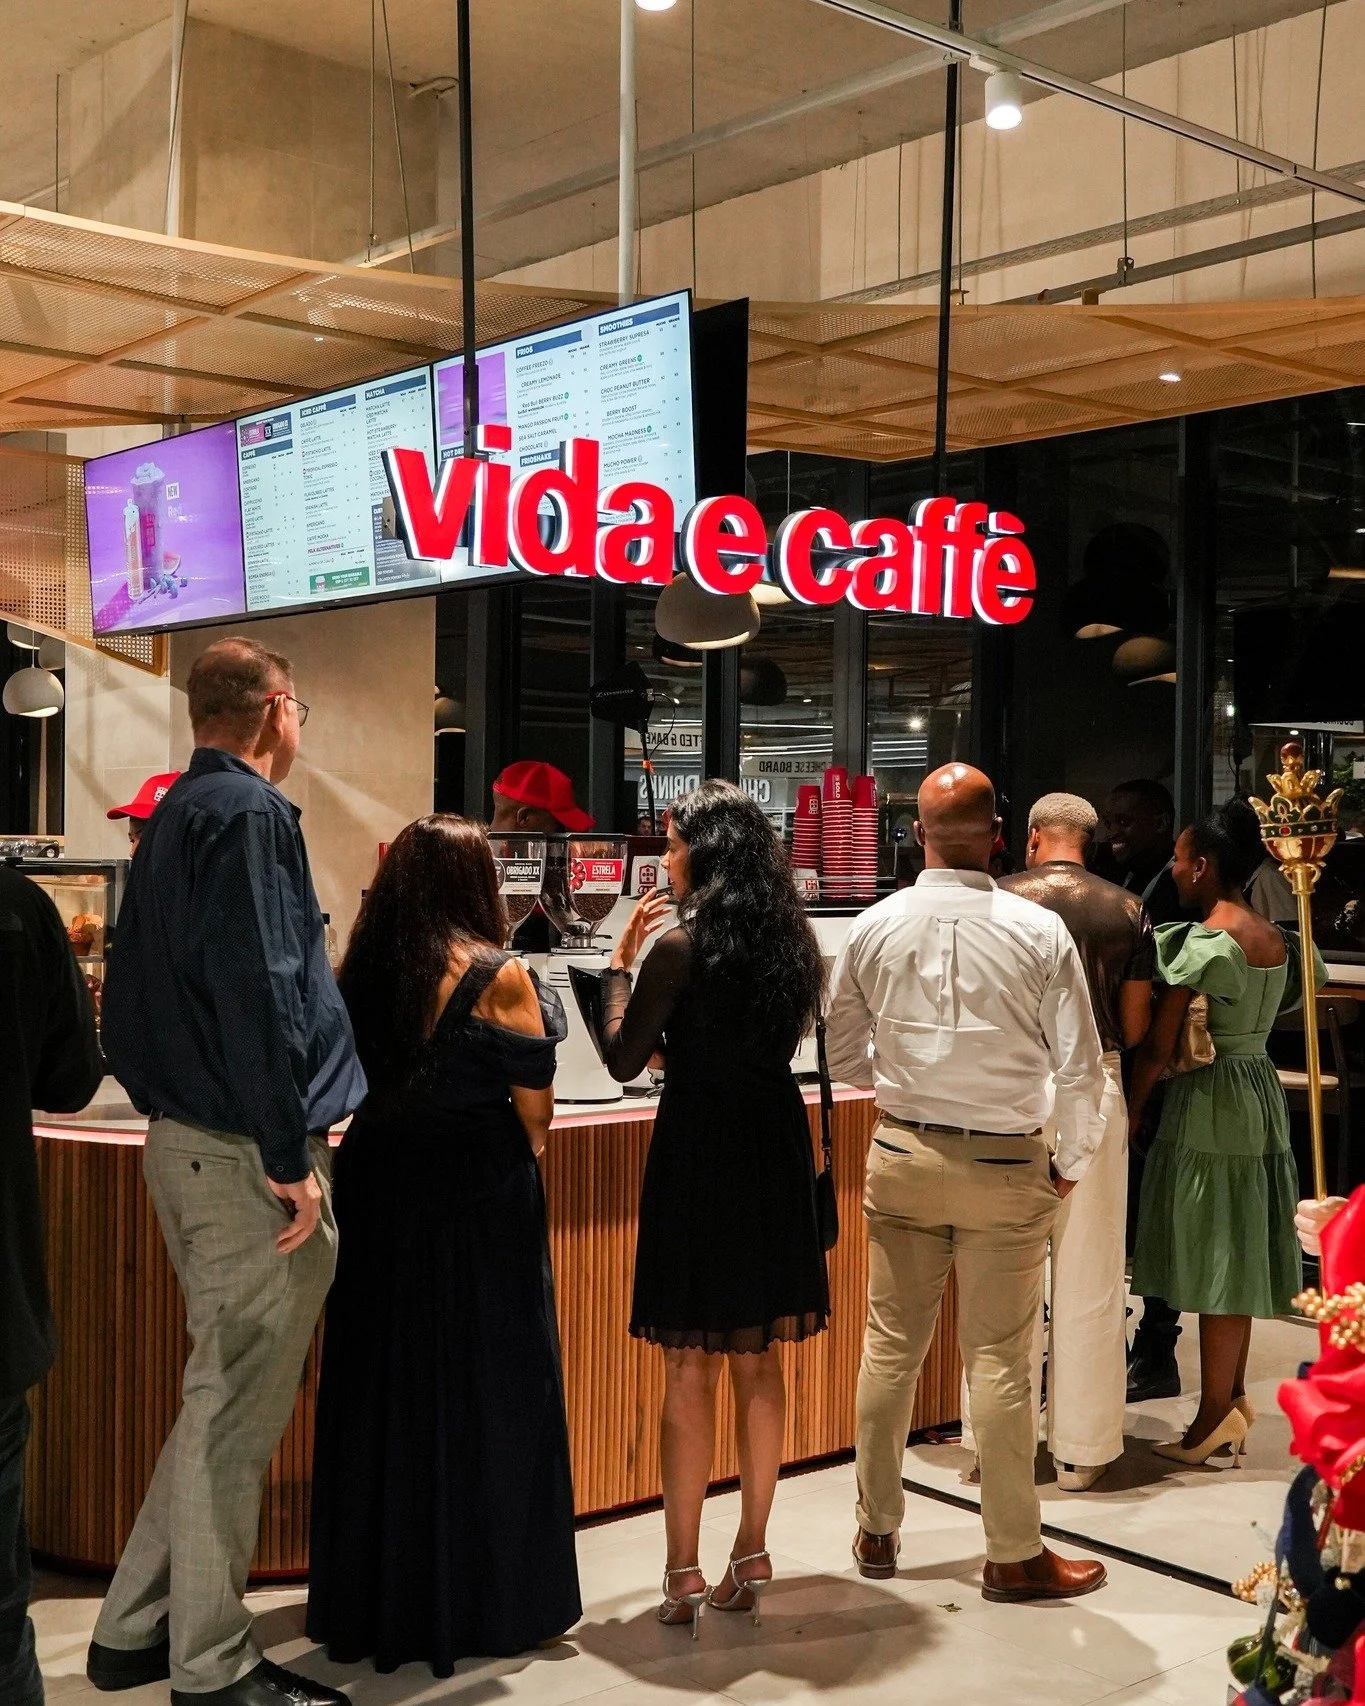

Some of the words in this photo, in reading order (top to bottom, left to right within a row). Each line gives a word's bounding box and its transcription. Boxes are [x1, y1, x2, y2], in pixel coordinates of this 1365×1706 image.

[599, 317, 634, 334] SMOOTHIES
[629, 330, 650, 341] SUPRESA
[516, 346, 534, 357] FRIOS
[618, 357, 637, 367] GREENS
[600, 385, 614, 395] CHOC
[614, 381, 633, 392] PEANUT
[632, 378, 651, 388] BUTTER
[366, 388, 386, 400] MATCHA
[552, 393, 564, 402] BUZZ
[606, 407, 620, 417] BERRY
[621, 404, 638, 414] BOOST
[607, 431, 624, 441] MOCHA
[624, 427, 647, 437] MADNESS
[443, 450, 455, 459] HOT
[520, 452, 552, 466] FRIOSHAKE
[604, 459, 620, 469] MUCHO
[620, 456, 638, 466] POWER
[167, 485, 178, 498] NEW
[383, 424, 675, 586] vida
[682, 495, 767, 595] e
[776, 496, 1037, 625] caffè
[506, 865, 533, 875] OBRIGADO
[532, 865, 540, 875] XX
[592, 864, 616, 876] ESTRELA
